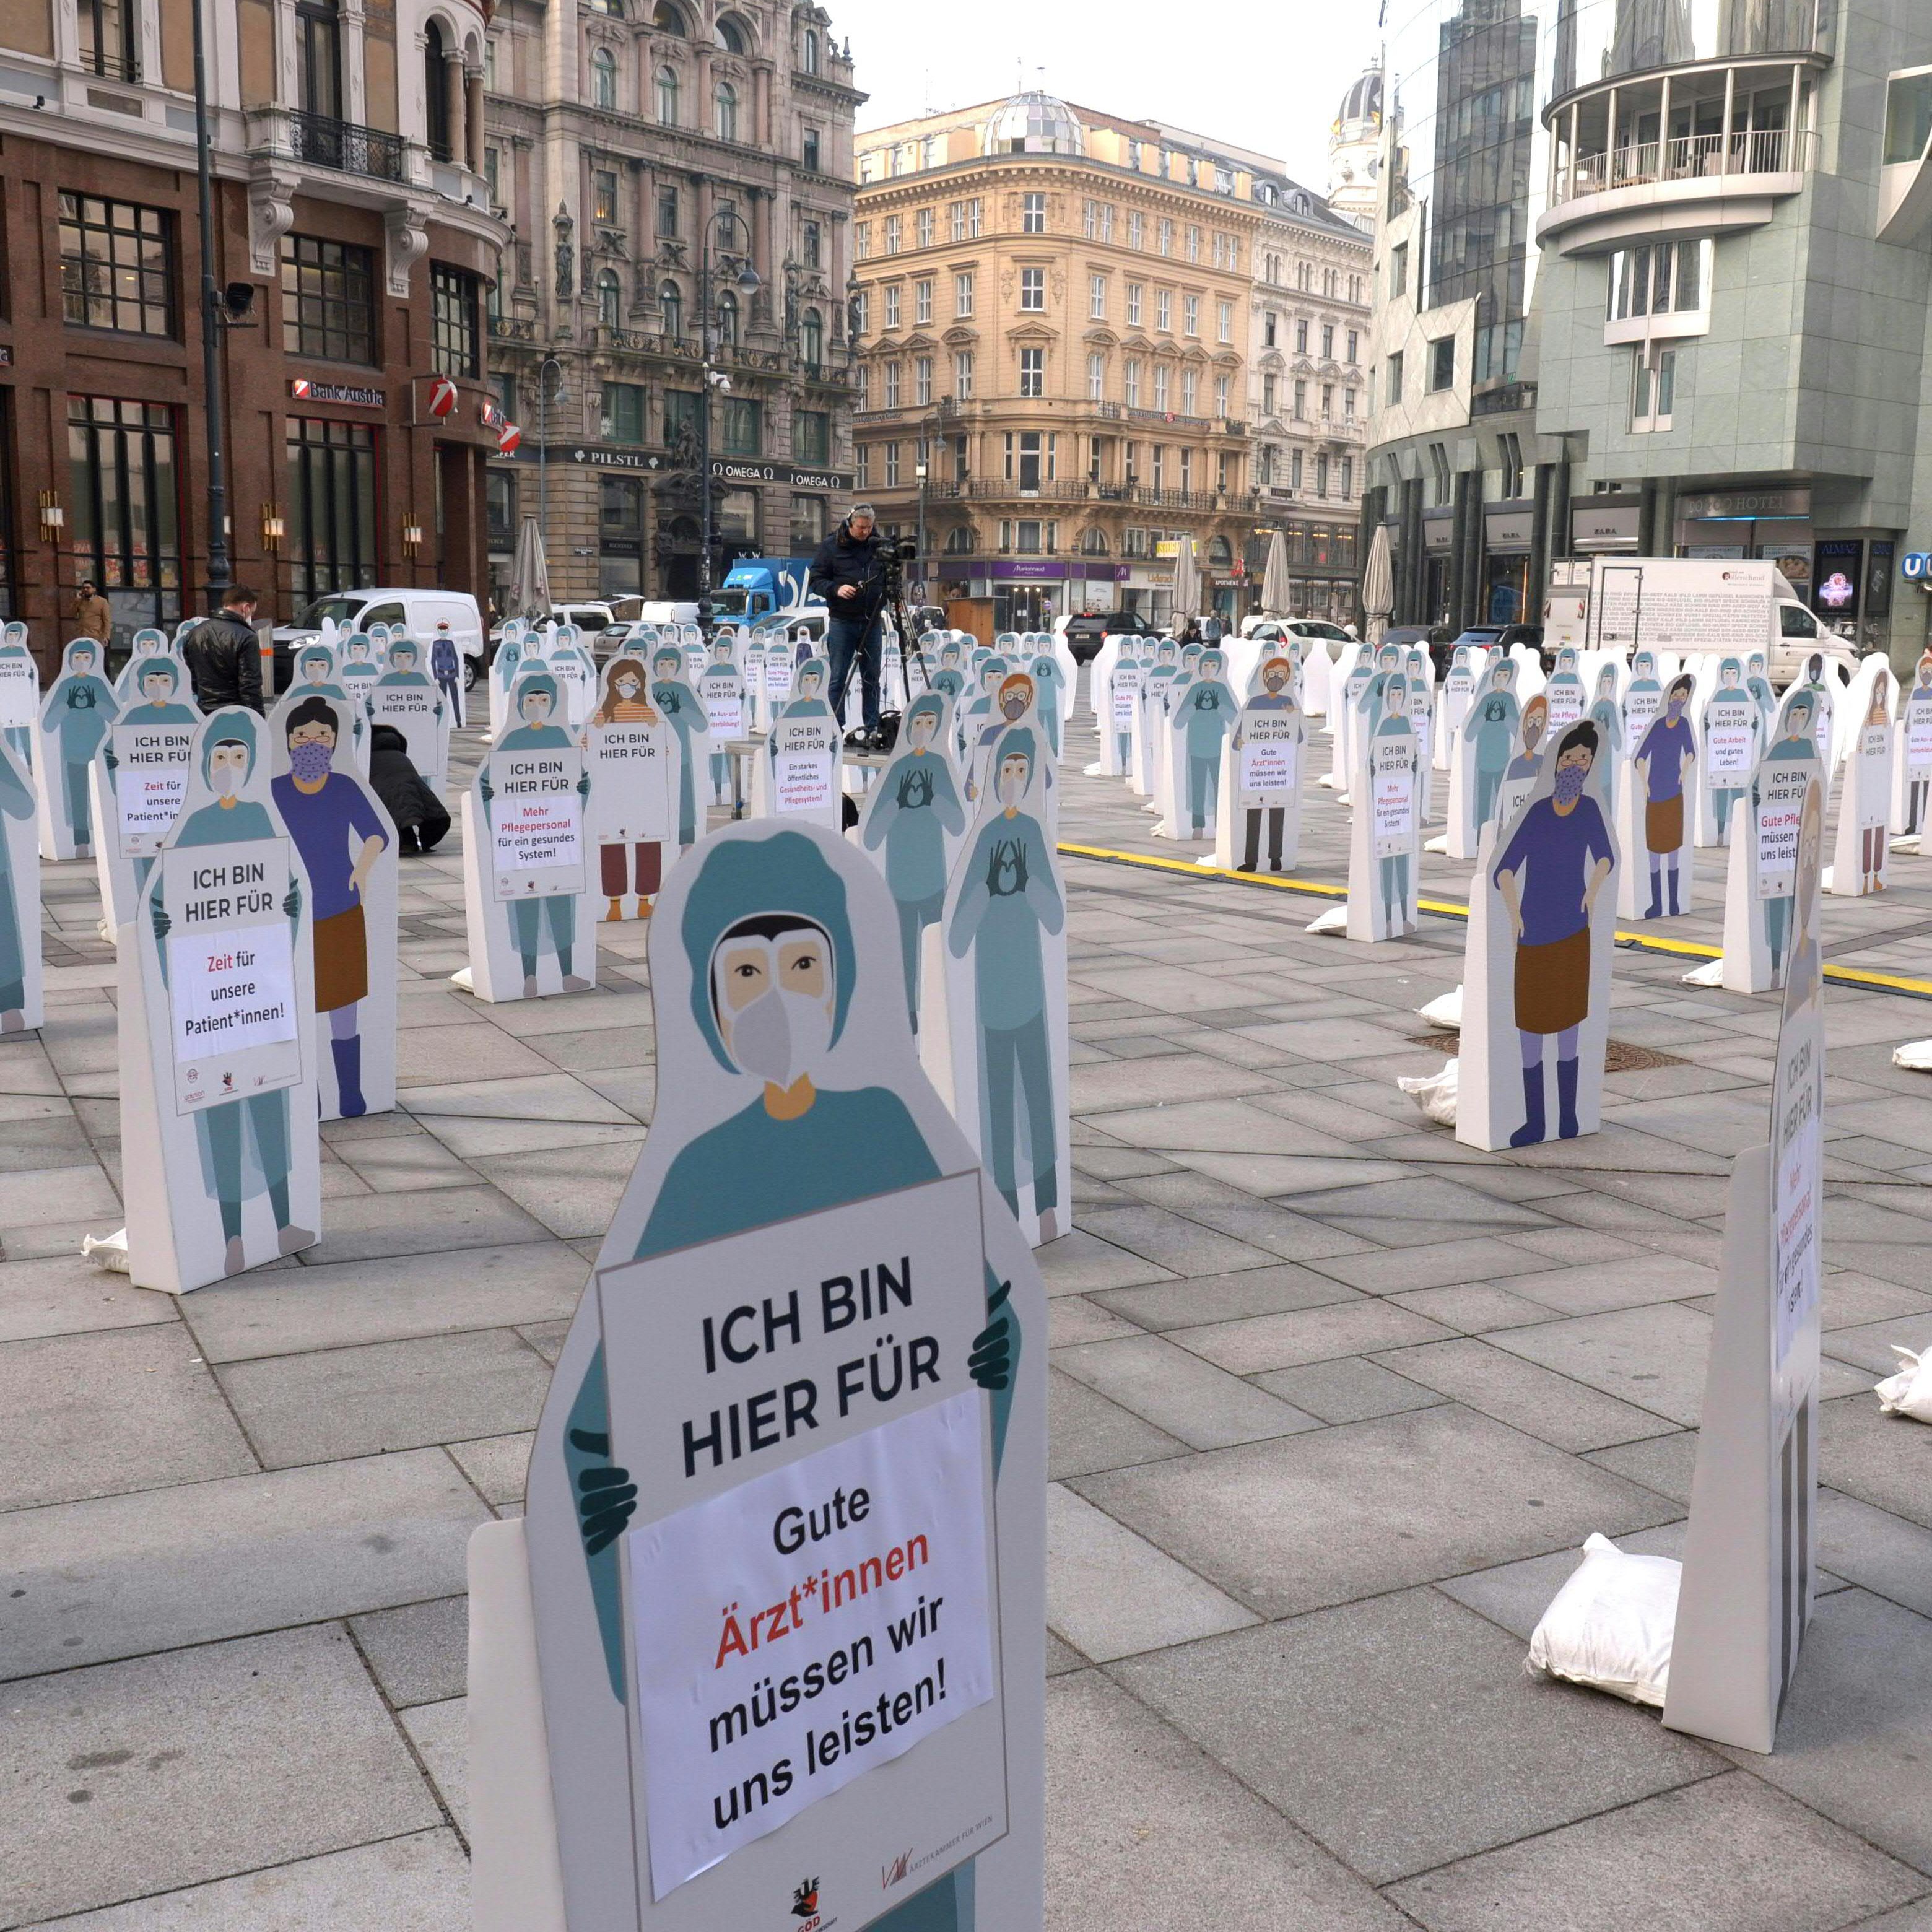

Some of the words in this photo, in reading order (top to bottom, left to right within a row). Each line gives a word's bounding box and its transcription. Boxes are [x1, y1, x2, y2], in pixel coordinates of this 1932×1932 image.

[311, 383, 341, 399] Bank
[344, 386, 383, 406] Austria
[591, 452, 643, 467] PILSTL
[726, 467, 760, 479] OMEGA
[796, 475, 828, 487] OMEGA
[1737, 496, 1784, 510] HOTEL
[1905, 558, 1921, 576] U
[409, 703, 428, 712] FÜR
[1414, 707, 1424, 715] FÜR
[1272, 720, 1287, 728] BIN
[790, 728, 804, 738] ICH
[807, 727, 821, 736] BIN
[1250, 732, 1270, 740] HIER
[1273, 730, 1290, 739] FÜR
[136, 737, 160, 747] ICH
[165, 736, 189, 746] BIN
[605, 734, 625, 744] ICH
[629, 734, 649, 743] BIN
[785, 742, 805, 751] HIER
[807, 739, 825, 749] FÜR
[600, 749, 628, 759] HIER
[632, 746, 655, 757] FÜR
[1383, 747, 1393, 756] ICH
[1395, 746, 1406, 755] BIN
[130, 753, 164, 763] HIER
[511, 764, 534, 775] ICH
[539, 762, 562, 773] BIN
[1380, 762, 1394, 772] HIER
[1396, 758, 1408, 769] FÜR
[788, 774, 819, 782] öffentliches
[1773, 773, 1789, 783] ICH
[1791, 772, 1807, 782] BIN
[144, 783, 164, 791] Zeit
[167, 781, 181, 790] für
[505, 781, 537, 794] HIER
[542, 777, 569, 791] FÜR
[780, 785, 816, 794] Gesundheits-
[785, 795, 822, 804] Pflegesystem!
[1513, 795, 1525, 808] ICH
[1767, 790, 1790, 801] HIER
[147, 798, 181, 806] unsere
[523, 807, 549, 817] Mehr
[502, 819, 570, 833] Pflegepersonal
[1762, 816, 1782, 827] Gute
[498, 838, 512, 848] für
[515, 837, 529, 846] ein
[531, 834, 575, 848] gesundes
[1762, 832, 1794, 844] müssen
[519, 848, 557, 861] System!
[1761, 850, 1776, 861] uns
[194, 868, 226, 890] ICH
[233, 863, 264, 885] BIN
[186, 899, 230, 923] HIER
[237, 890, 272, 916] FÜR
[208, 954, 233, 972] Zeit
[236, 951, 255, 968] für
[211, 981, 255, 1001] unsere
[702, 1290, 801, 1374] ICH
[821, 1256, 913, 1335] BIN
[682, 1377, 817, 1477] HIER
[836, 1336, 940, 1417] FÜR
[773, 1486, 871, 1556] Gute
[710, 1635, 874, 1753] müssen
[887, 1596, 944, 1651] wir
[713, 1763, 793, 1830] uns
[806, 1658, 947, 1776] leisten!
[910, 1834, 960, 1874] ÄRZTEKAMMER
[962, 1828, 975, 1840] FÜR
[975, 1815, 993, 1830] WIEN
